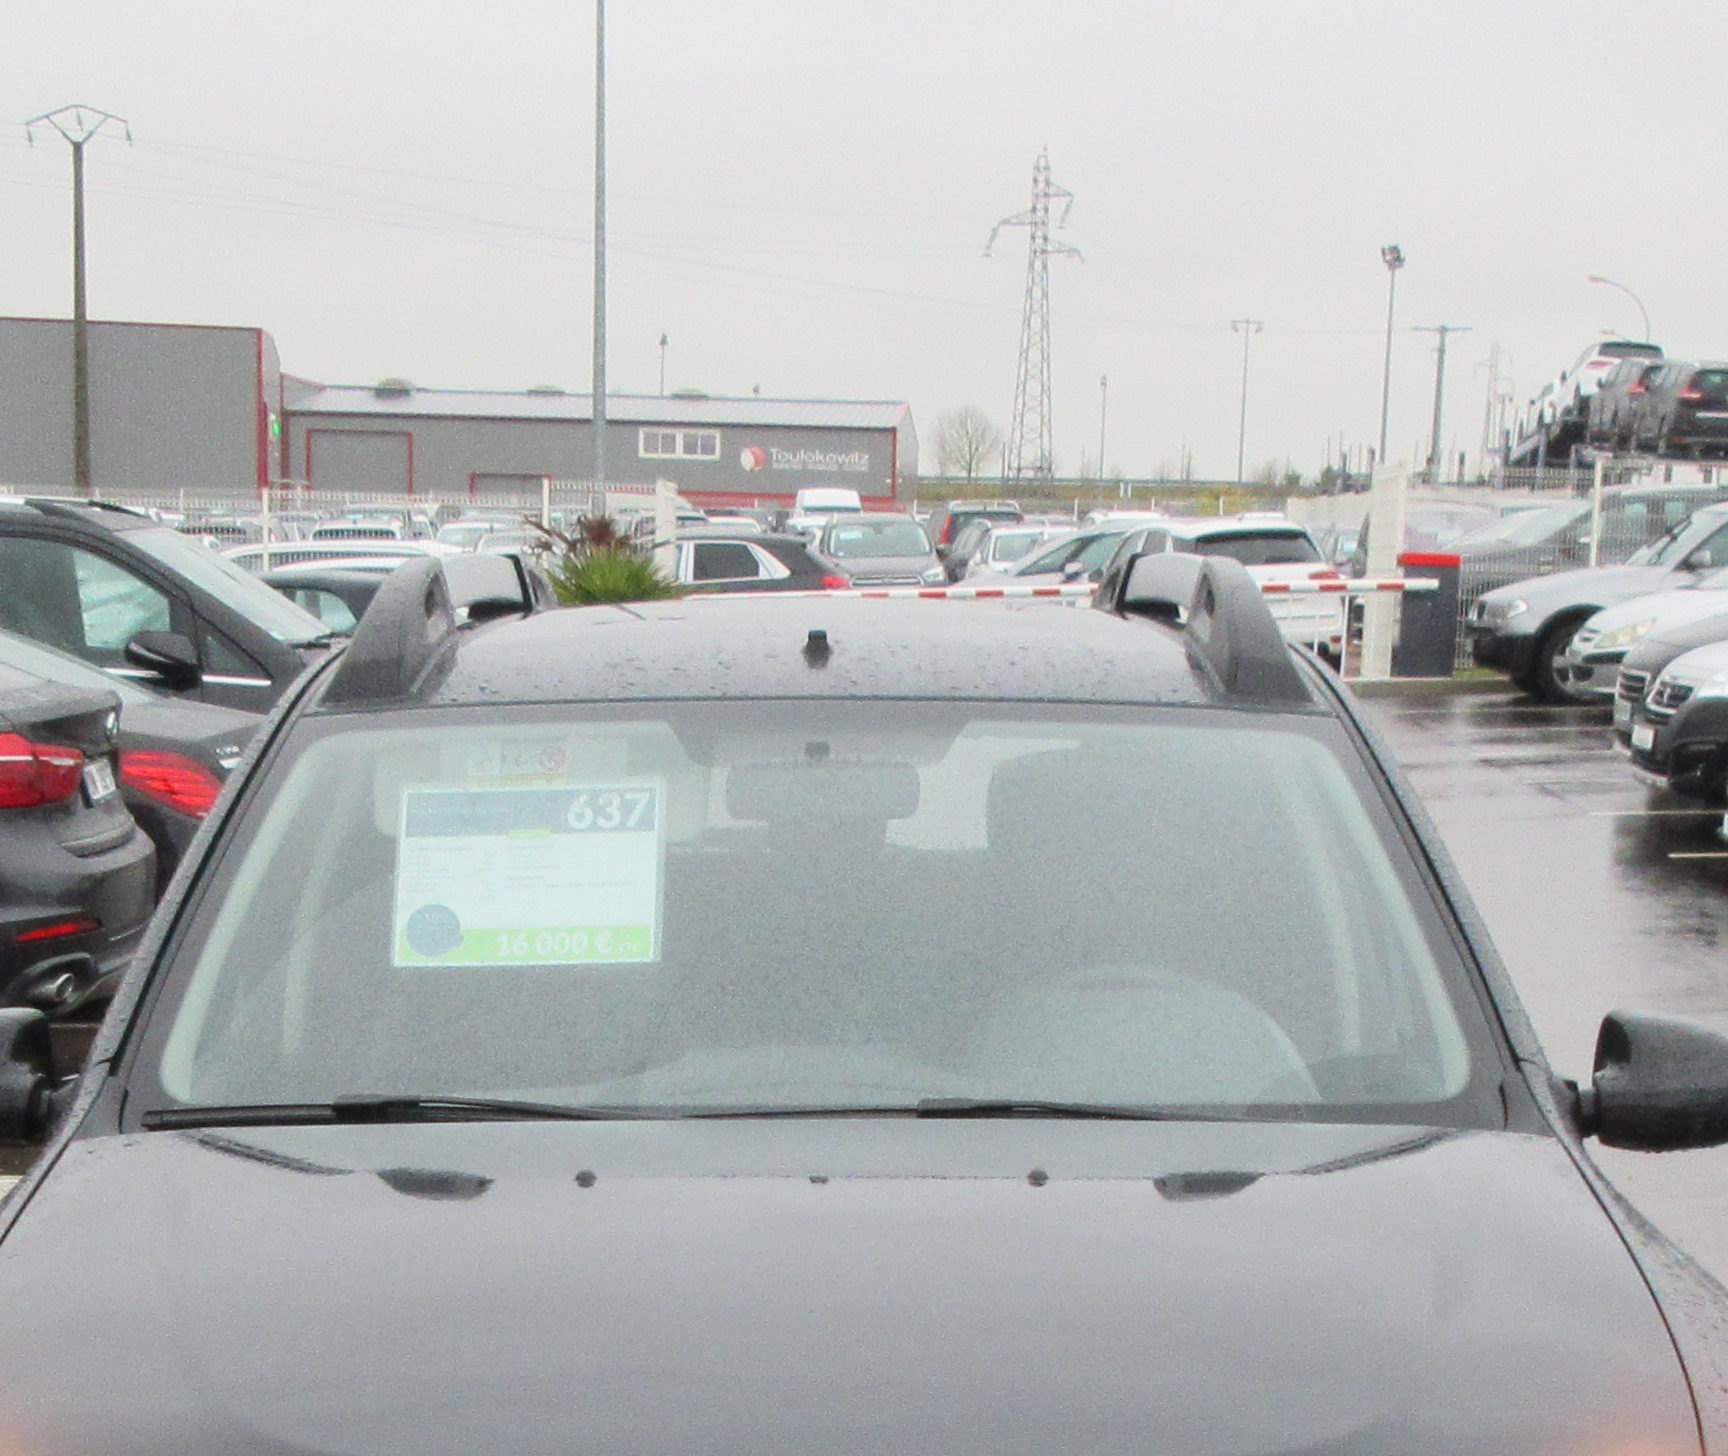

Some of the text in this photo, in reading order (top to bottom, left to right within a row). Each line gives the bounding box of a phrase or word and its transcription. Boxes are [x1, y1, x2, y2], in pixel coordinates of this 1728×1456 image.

[770, 448, 869, 465] Toulokowitz
[567, 789, 650, 830] 637
[496, 932, 530, 956] 16
[535, 930, 589, 954] 000
